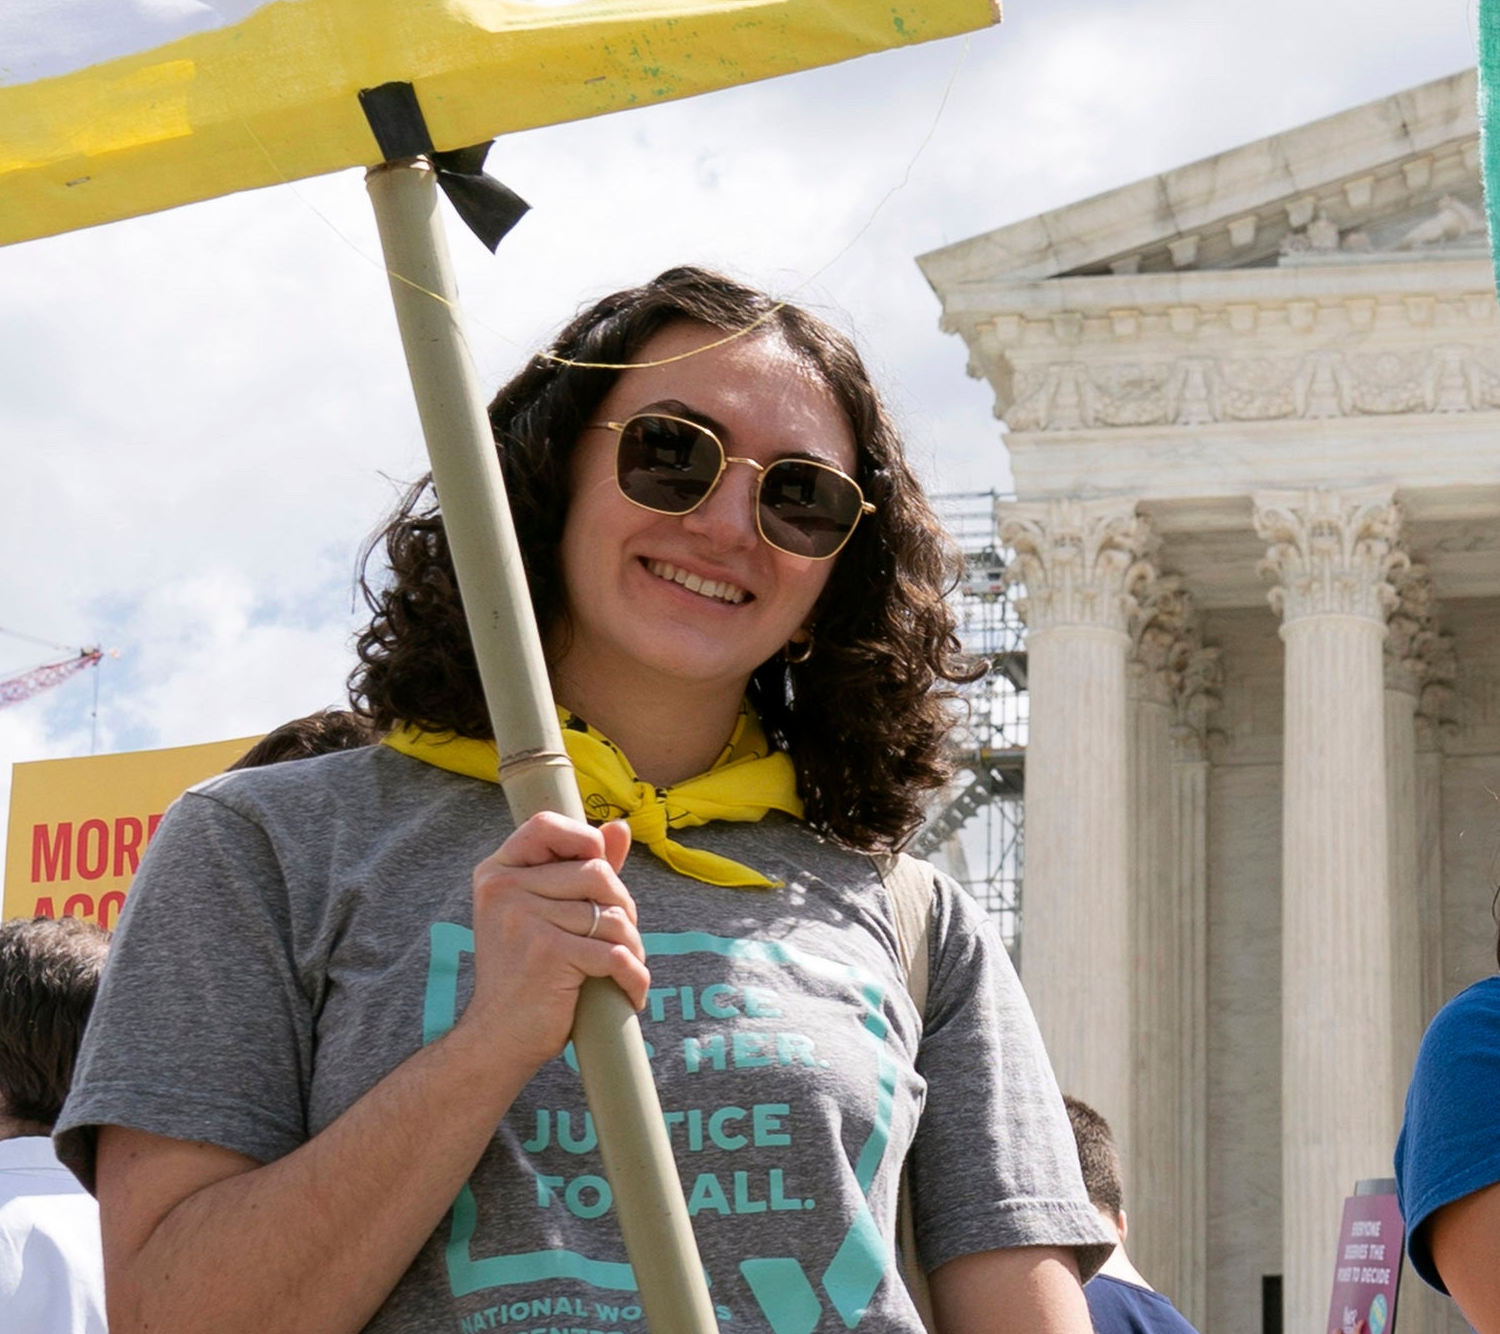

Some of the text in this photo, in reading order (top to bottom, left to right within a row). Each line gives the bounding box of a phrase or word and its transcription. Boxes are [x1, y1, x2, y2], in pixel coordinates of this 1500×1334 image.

[649, 983, 783, 1022] TICE
[685, 1032, 830, 1074] HER.
[522, 1103, 791, 1155] JUTICE
[536, 1168, 817, 1220] FO ALL.
[1360, 1267, 1391, 1285] DECIDE
